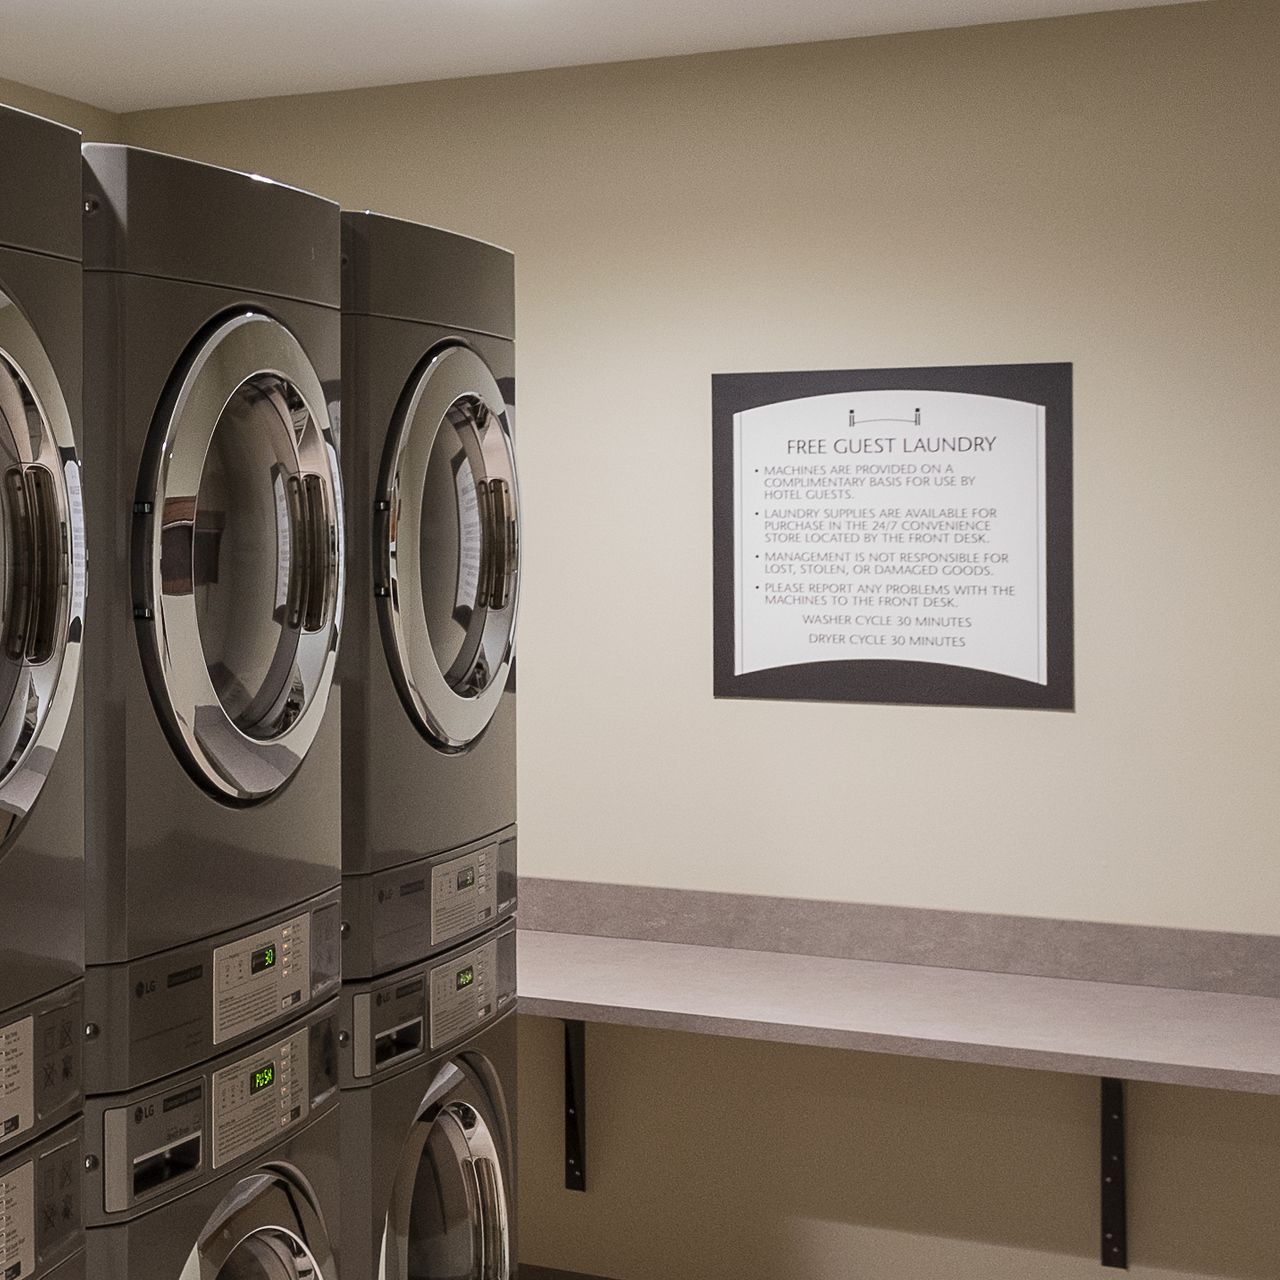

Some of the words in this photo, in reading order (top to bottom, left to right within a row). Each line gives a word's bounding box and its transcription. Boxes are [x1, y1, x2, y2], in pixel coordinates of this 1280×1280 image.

[787, 439, 828, 455] FREE
[833, 438, 896, 454] GUEST
[903, 436, 997, 453] LAUNDRY
[764, 466, 826, 475] MACHINES
[830, 465, 852, 475] ARE
[855, 464, 917, 475] PROVIDED
[920, 464, 941, 474] ON
[945, 464, 954, 474] A
[764, 477, 866, 488] COMPLIMENTARY
[869, 477, 902, 487] BASIS
[906, 476, 930, 487] FOR
[934, 476, 957, 486] USE
[961, 476, 976, 486] BY
[764, 489, 802, 499] HOTEL
[805, 489, 855, 500] GUESTS.
[764, 509, 819, 519] LAUNDRY
[824, 508, 876, 519] SUPPLIES
[879, 508, 901, 518] ARE
[905, 508, 968, 519] AVAILABLE
[972, 508, 997, 519] FOR
[764, 521, 824, 531] PURCHASE
[829, 521, 840, 531] IN
[847, 521, 868, 531] THE
[872, 521, 897, 531] 24/7
[901, 521, 991, 531] CONVENIENCE
[765, 533, 801, 543] STORE
[805, 533, 860, 543] LOCATED
[864, 533, 878, 543] BY
[883, 533, 905, 543] THE
[909, 533, 950, 543] FRONT
[953, 533, 990, 543] DESK.
[765, 552, 851, 562] MANAGEMENT
[855, 552, 865, 562] IS
[869, 552, 896, 562] NOT
[900, 552, 980, 563] RESPONSIBLE
[984, 553, 1009, 564] FOR
[765, 564, 796, 575] LOST,
[800, 564, 849, 576] STOLEN,
[853, 565, 870, 574] OR
[874, 565, 938, 575] DAMAGED
[942, 566, 994, 576] GOODS.
[765, 583, 805, 593] PLEASE
[808, 583, 853, 593] REPORT
[857, 584, 883, 593] ANY
[886, 584, 951, 594] PROBLEMS
[953, 585, 987, 595] WITH
[991, 585, 1016, 596] THE
[765, 595, 827, 605] MACHINES
[832, 596, 848, 606] TO
[853, 596, 873, 606] THE
[878, 596, 918, 606] FRONT
[923, 597, 958, 607] DESK.
[802, 615, 852, 625] WASHER
[855, 615, 892, 625] CYCLE
[897, 616, 912, 626] 30
[915, 617, 972, 627] MINUTES
[808, 633, 846, 644] DRYER
[849, 634, 887, 645] CYCLE
[891, 635, 906, 646] 30
[909, 636, 966, 647] MINUTES
